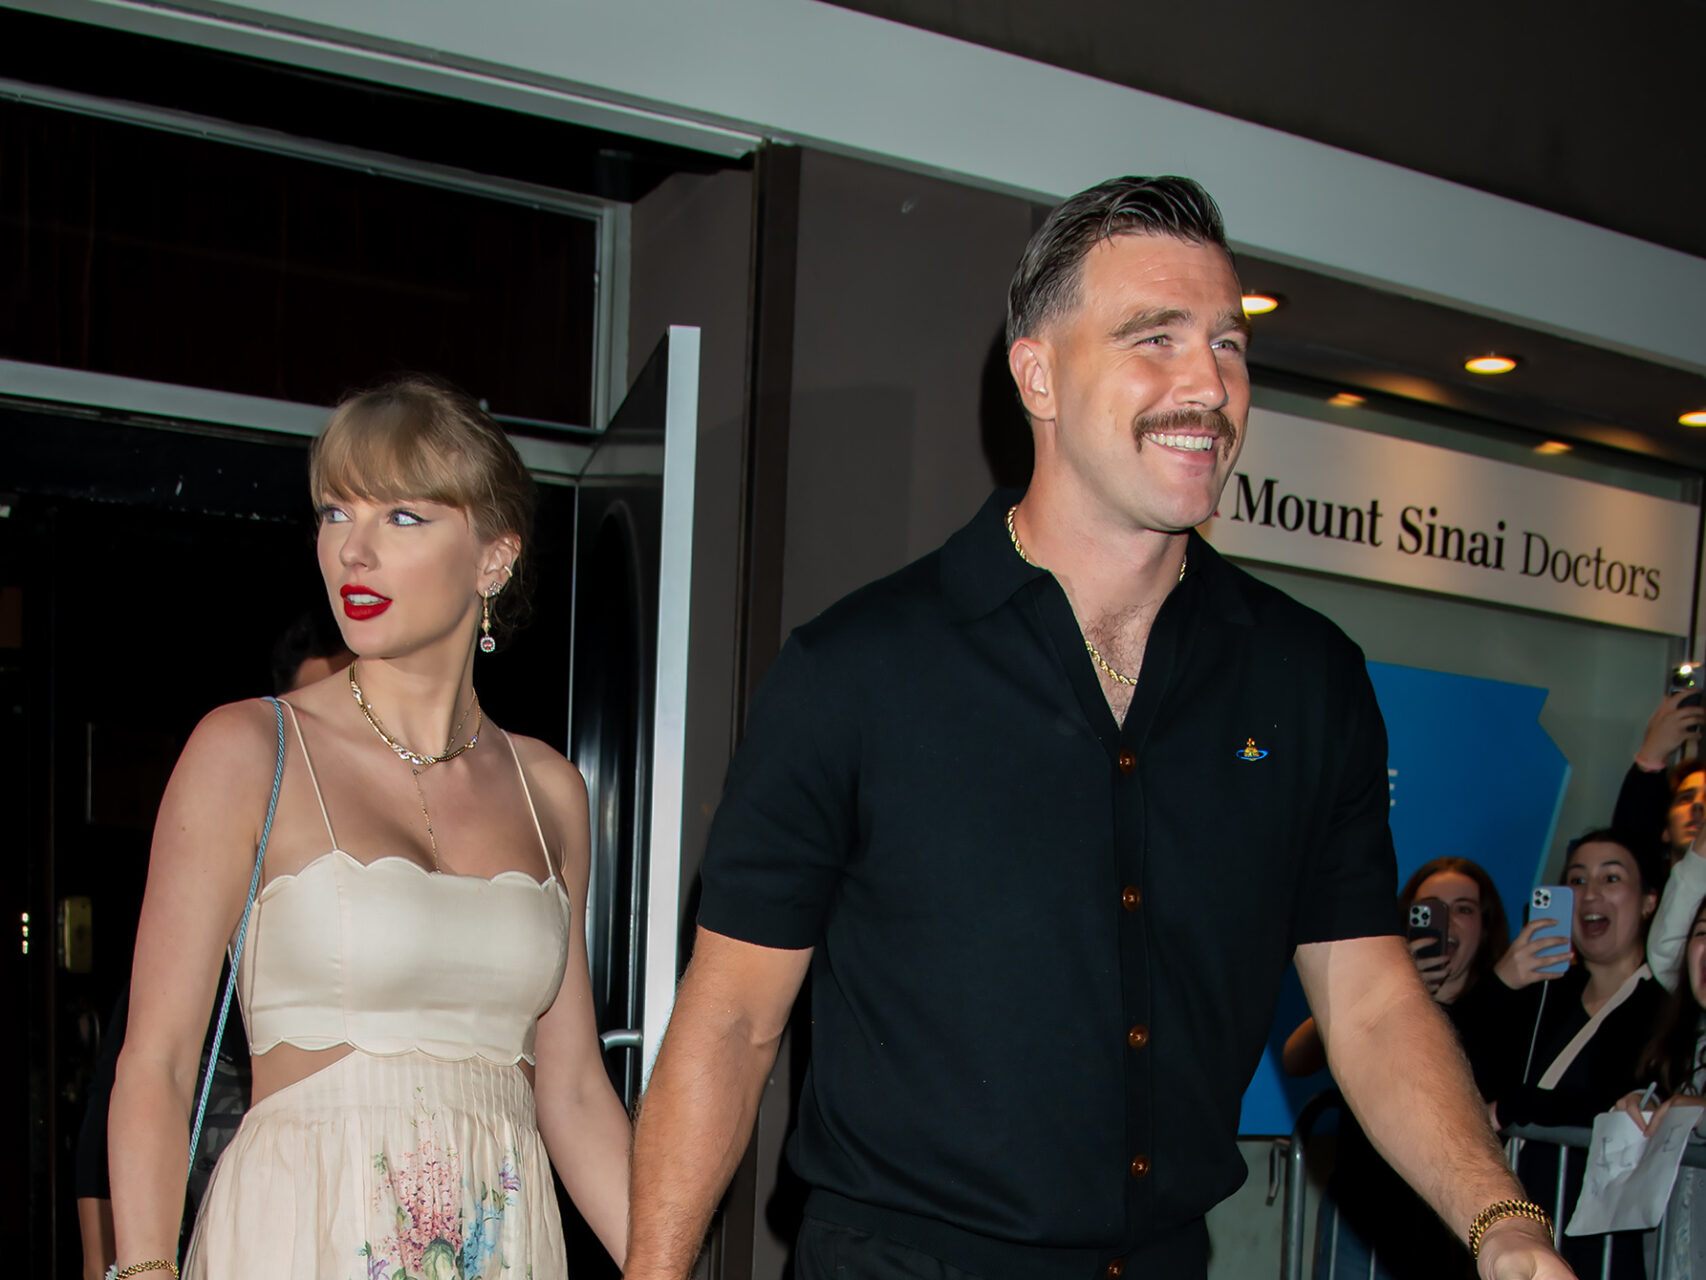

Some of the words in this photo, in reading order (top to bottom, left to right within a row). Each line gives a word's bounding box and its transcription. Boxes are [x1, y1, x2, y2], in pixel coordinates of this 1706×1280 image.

[1230, 472, 1383, 547] Mount
[1397, 506, 1506, 571] Sinai
[1520, 530, 1661, 601] Doctors
